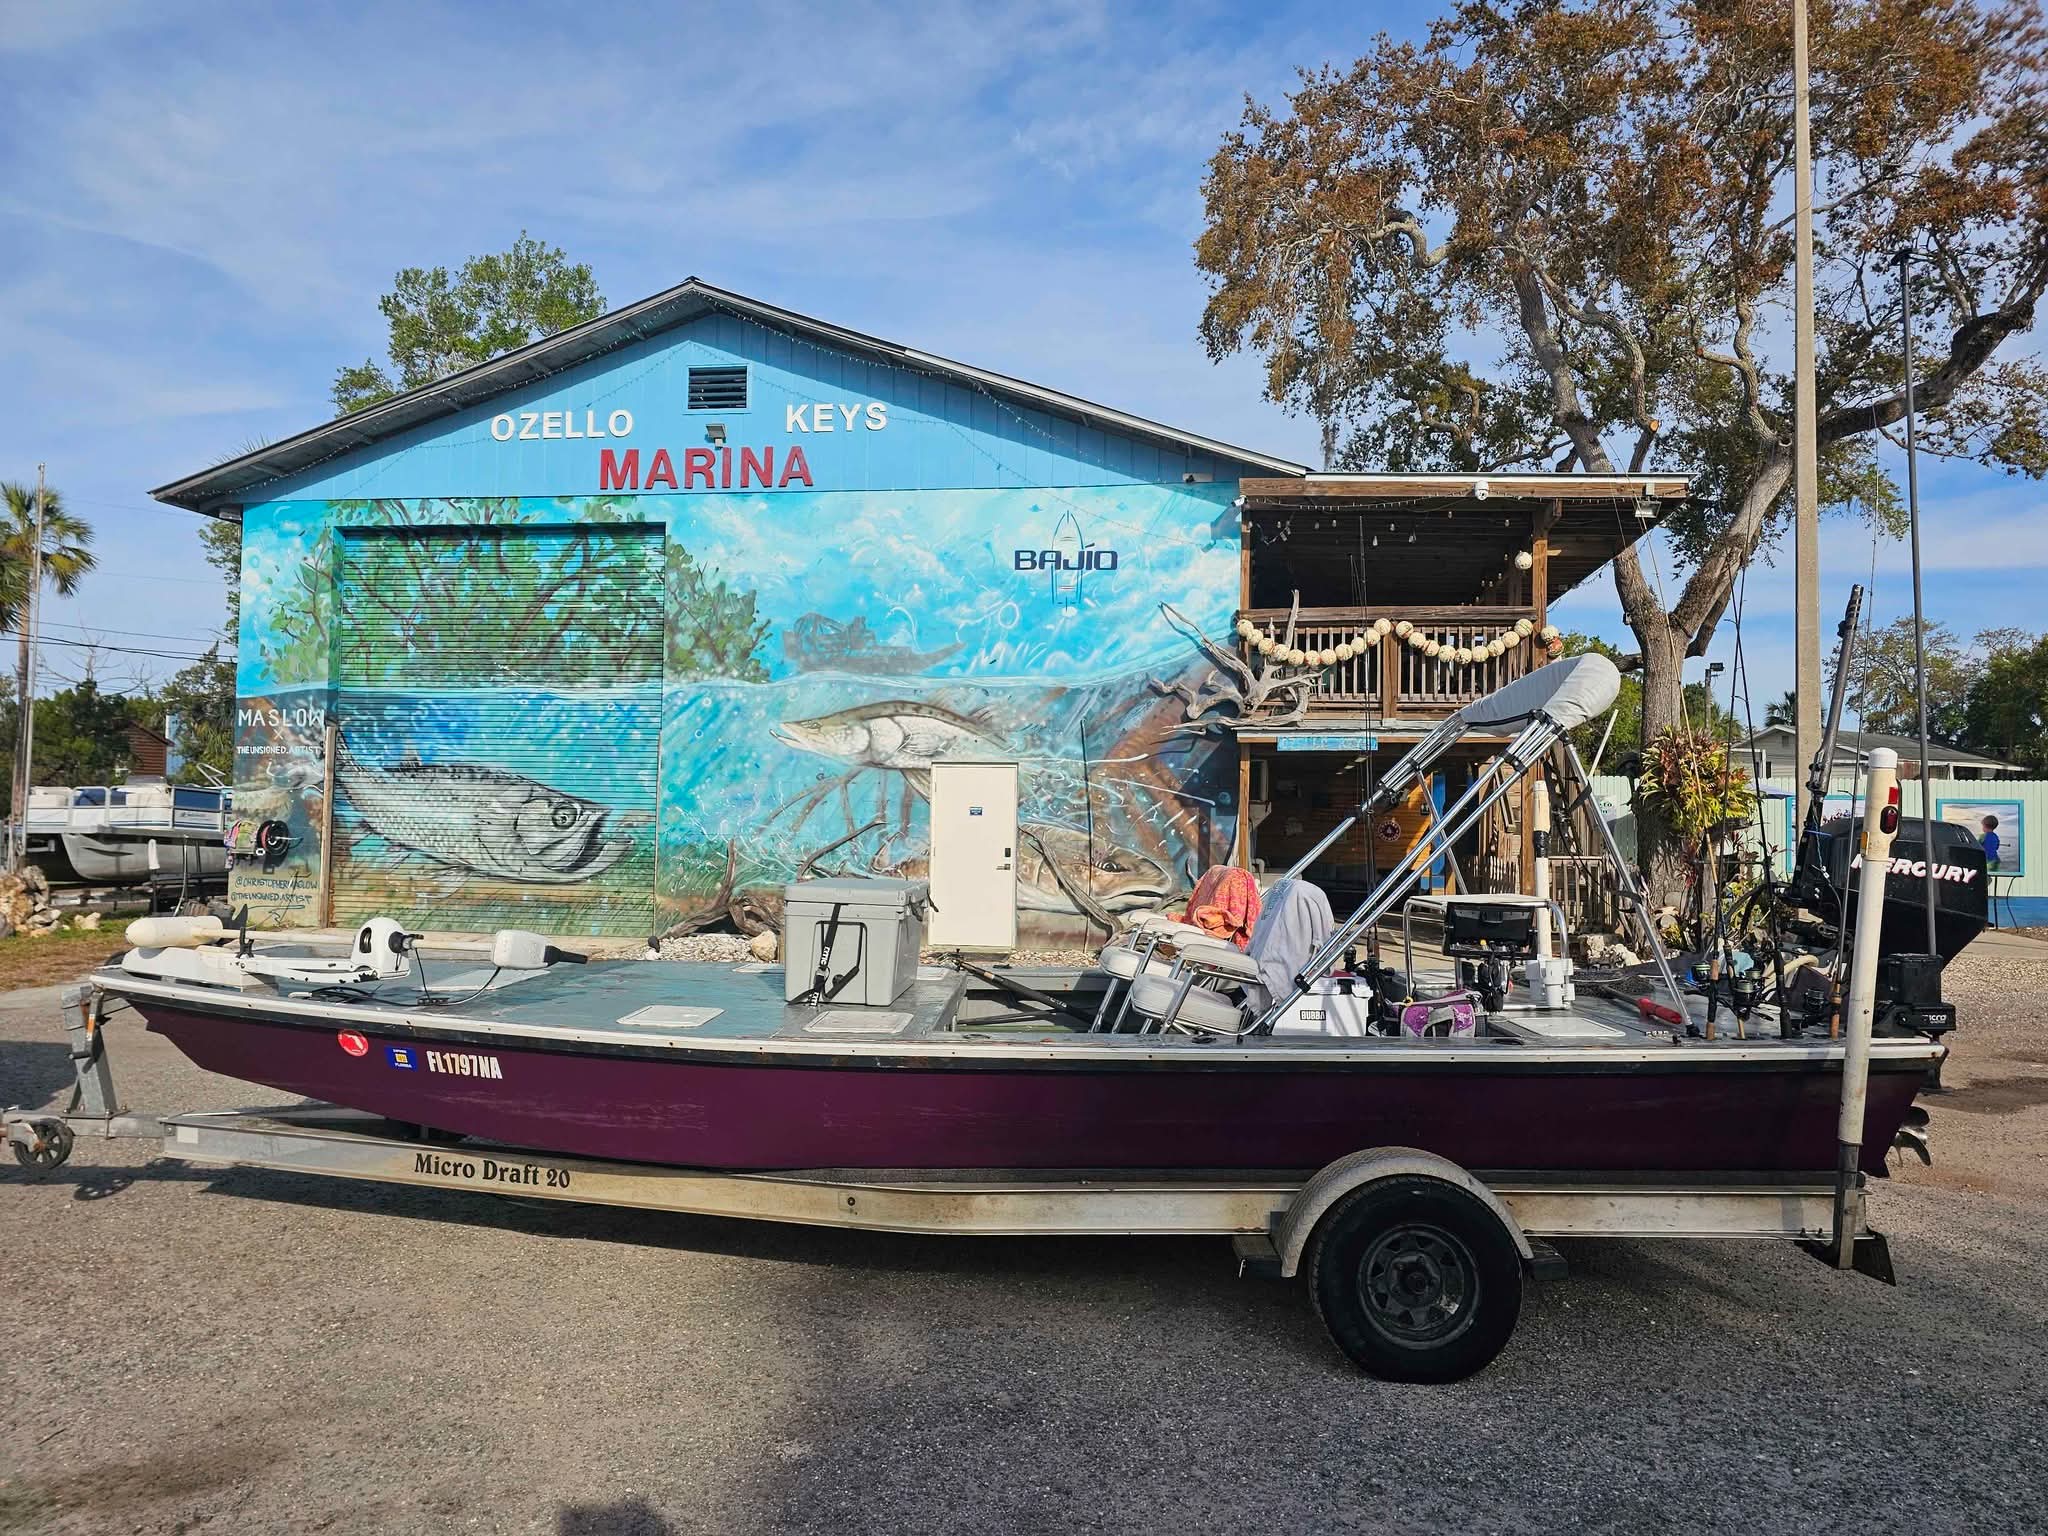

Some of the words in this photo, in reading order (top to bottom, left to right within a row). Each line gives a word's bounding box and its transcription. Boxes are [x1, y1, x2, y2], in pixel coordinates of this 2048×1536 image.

[491, 409, 634, 441] OZELLO
[786, 402, 888, 433] KEYS
[599, 445, 814, 489] MARINA
[238, 708, 325, 727] MASLOW
[1301, 1010, 1325, 1020] BUBBA
[426, 1050, 503, 1079] FL1797NA
[414, 1152, 476, 1178] Micro
[482, 1159, 540, 1185] Draft
[546, 1168, 571, 1188] 20
